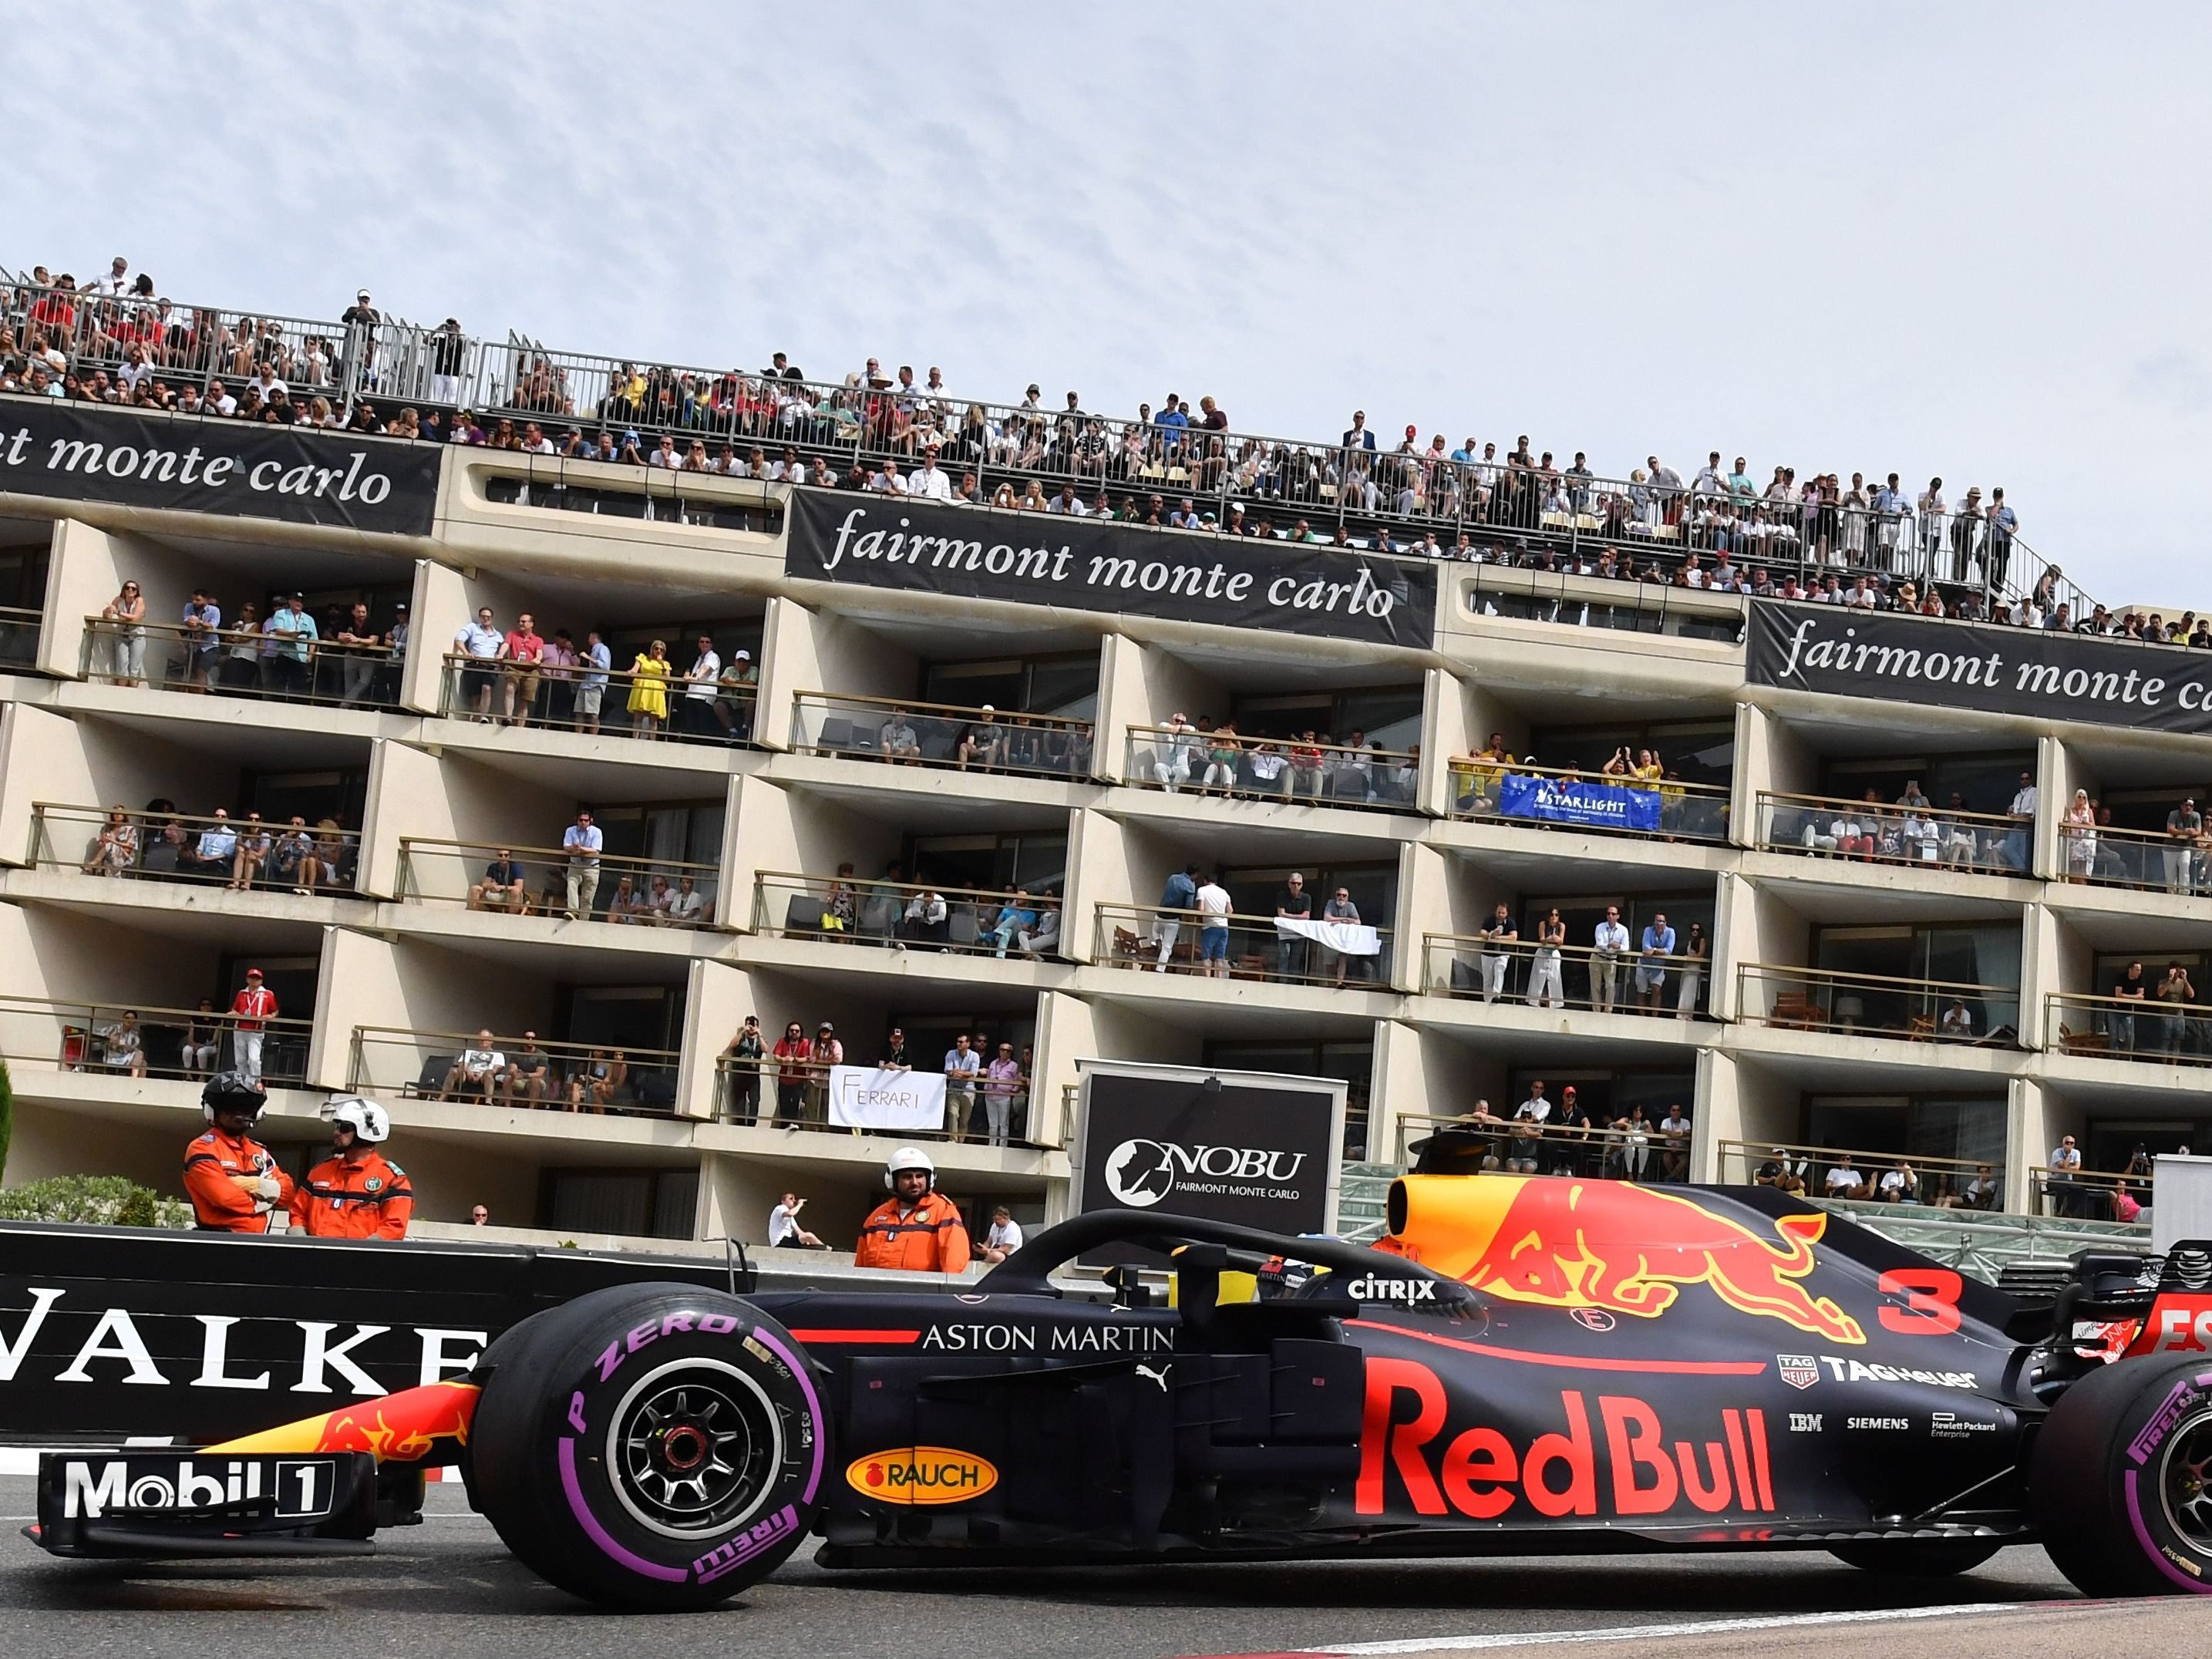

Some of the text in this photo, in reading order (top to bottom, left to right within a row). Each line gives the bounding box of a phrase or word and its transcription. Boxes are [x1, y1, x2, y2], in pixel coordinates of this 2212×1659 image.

[46, 437, 234, 486] monte
[249, 452, 391, 504] carlo
[823, 508, 1394, 618] fairmont monte carlo
[1779, 619, 2004, 688] fairmont
[2015, 661, 2166, 705] monte
[1547, 793, 1627, 813] STARLIGHT
[1155, 1142, 1308, 1181] NOBU
[1176, 1181, 1300, 1200] FAIRMONT MONTE CARLO
[1877, 1268, 1963, 1335] 3
[594, 1312, 739, 1382] ZERO
[922, 1324, 1174, 1352] ASTON MARTIN
[1780, 1357, 1813, 1368] TAG
[1782, 1368, 1817, 1386] HEUER
[1789, 1413, 1823, 1432] IBM
[1847, 1417, 1909, 1430] SIEMENS
[1931, 1429, 1971, 1439] Enterprise
[1932, 1421, 1996, 1432] Hewlett Packard
[887, 1463, 978, 1487] RAUCH
[64, 1462, 315, 1518] Mobil 1
[693, 1504, 800, 1585] PIRELLI
